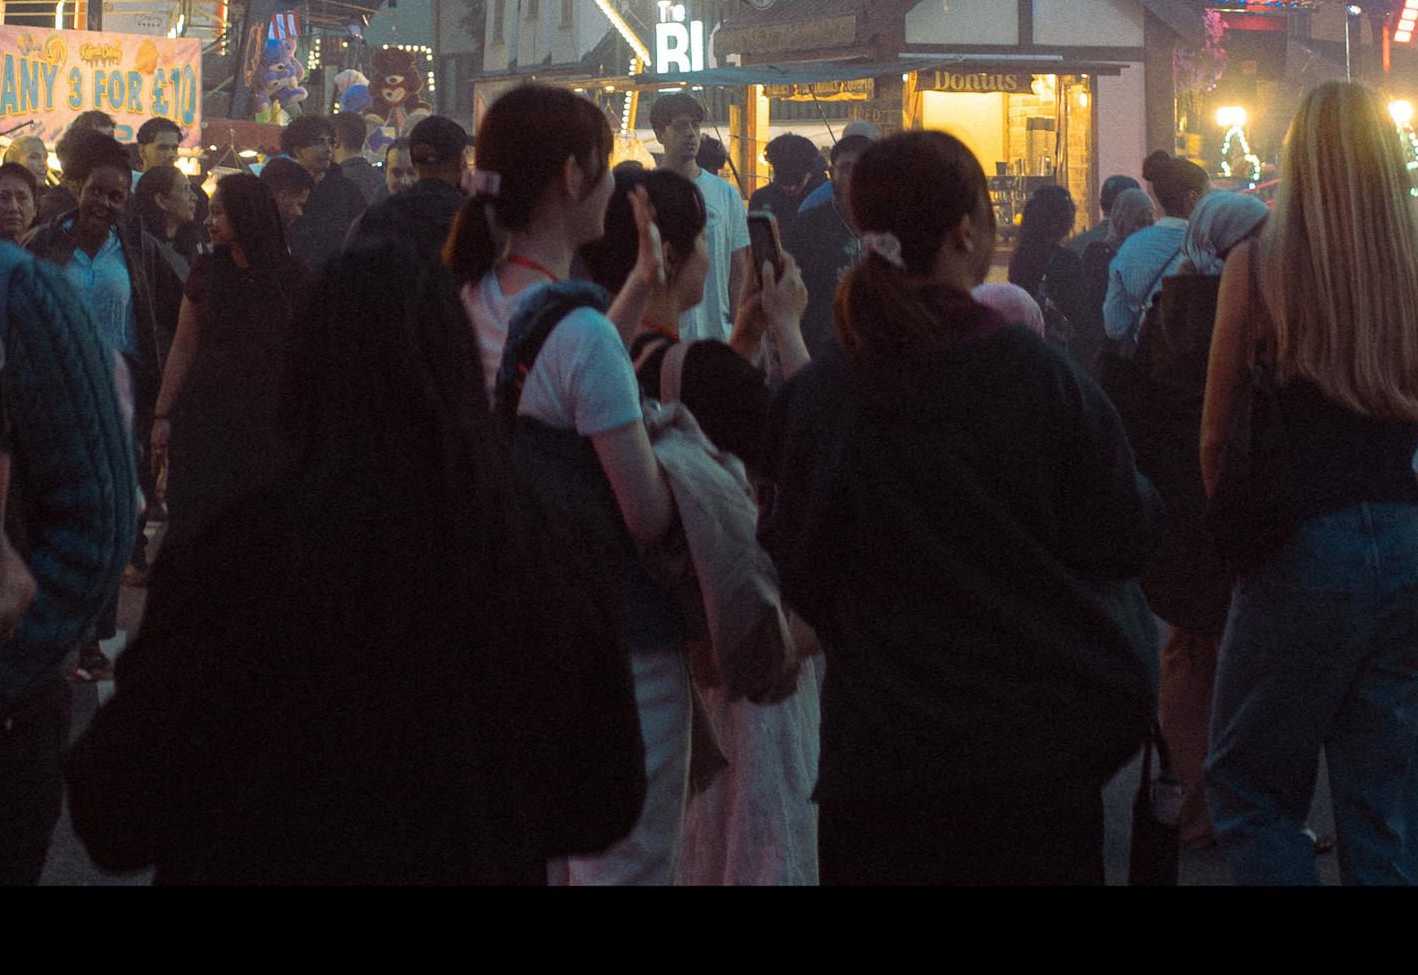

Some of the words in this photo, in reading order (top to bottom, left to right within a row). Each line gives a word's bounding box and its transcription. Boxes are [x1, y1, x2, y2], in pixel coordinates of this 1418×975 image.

[67, 65, 84, 110] 3
[93, 69, 145, 114] FOR
[150, 63, 198, 126] £10
